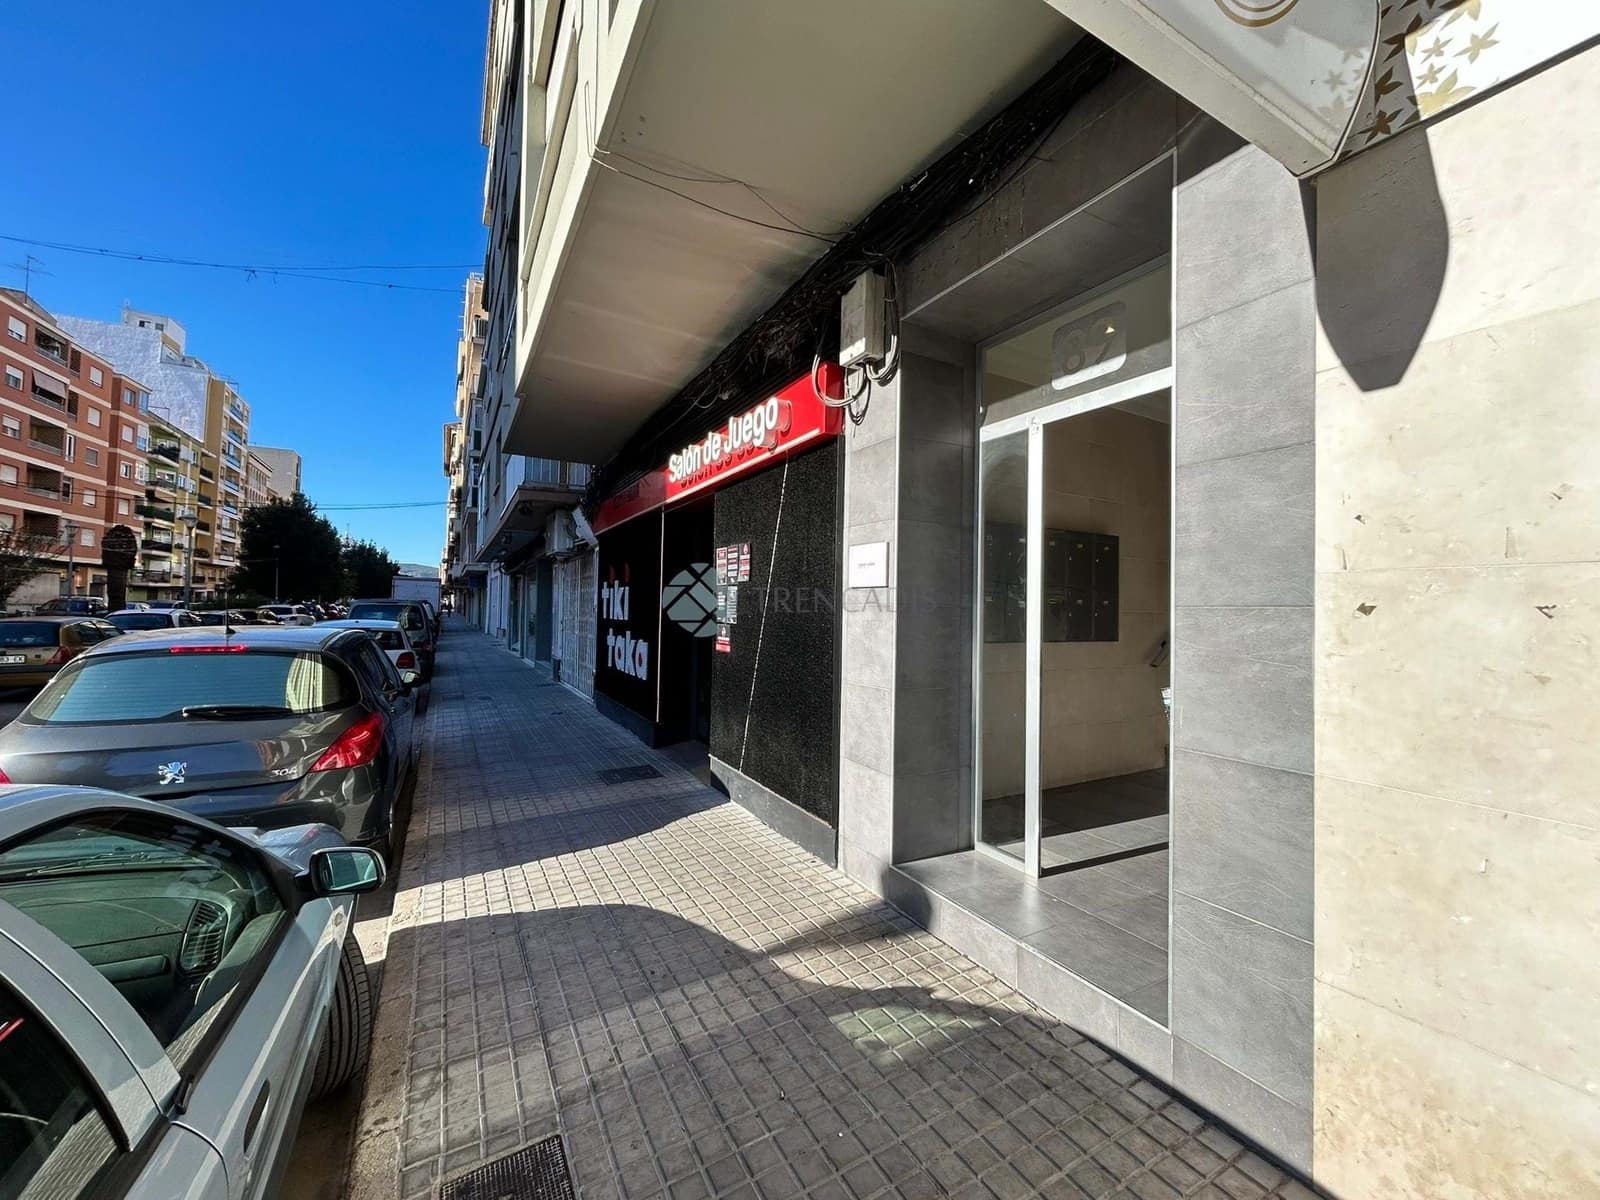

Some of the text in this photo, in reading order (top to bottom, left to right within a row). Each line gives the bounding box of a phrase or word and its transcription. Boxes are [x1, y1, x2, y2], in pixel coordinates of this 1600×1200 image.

[668, 397, 779, 483] Salón de Juego
[601, 577, 630, 620] tiki
[606, 628, 648, 680] taka
